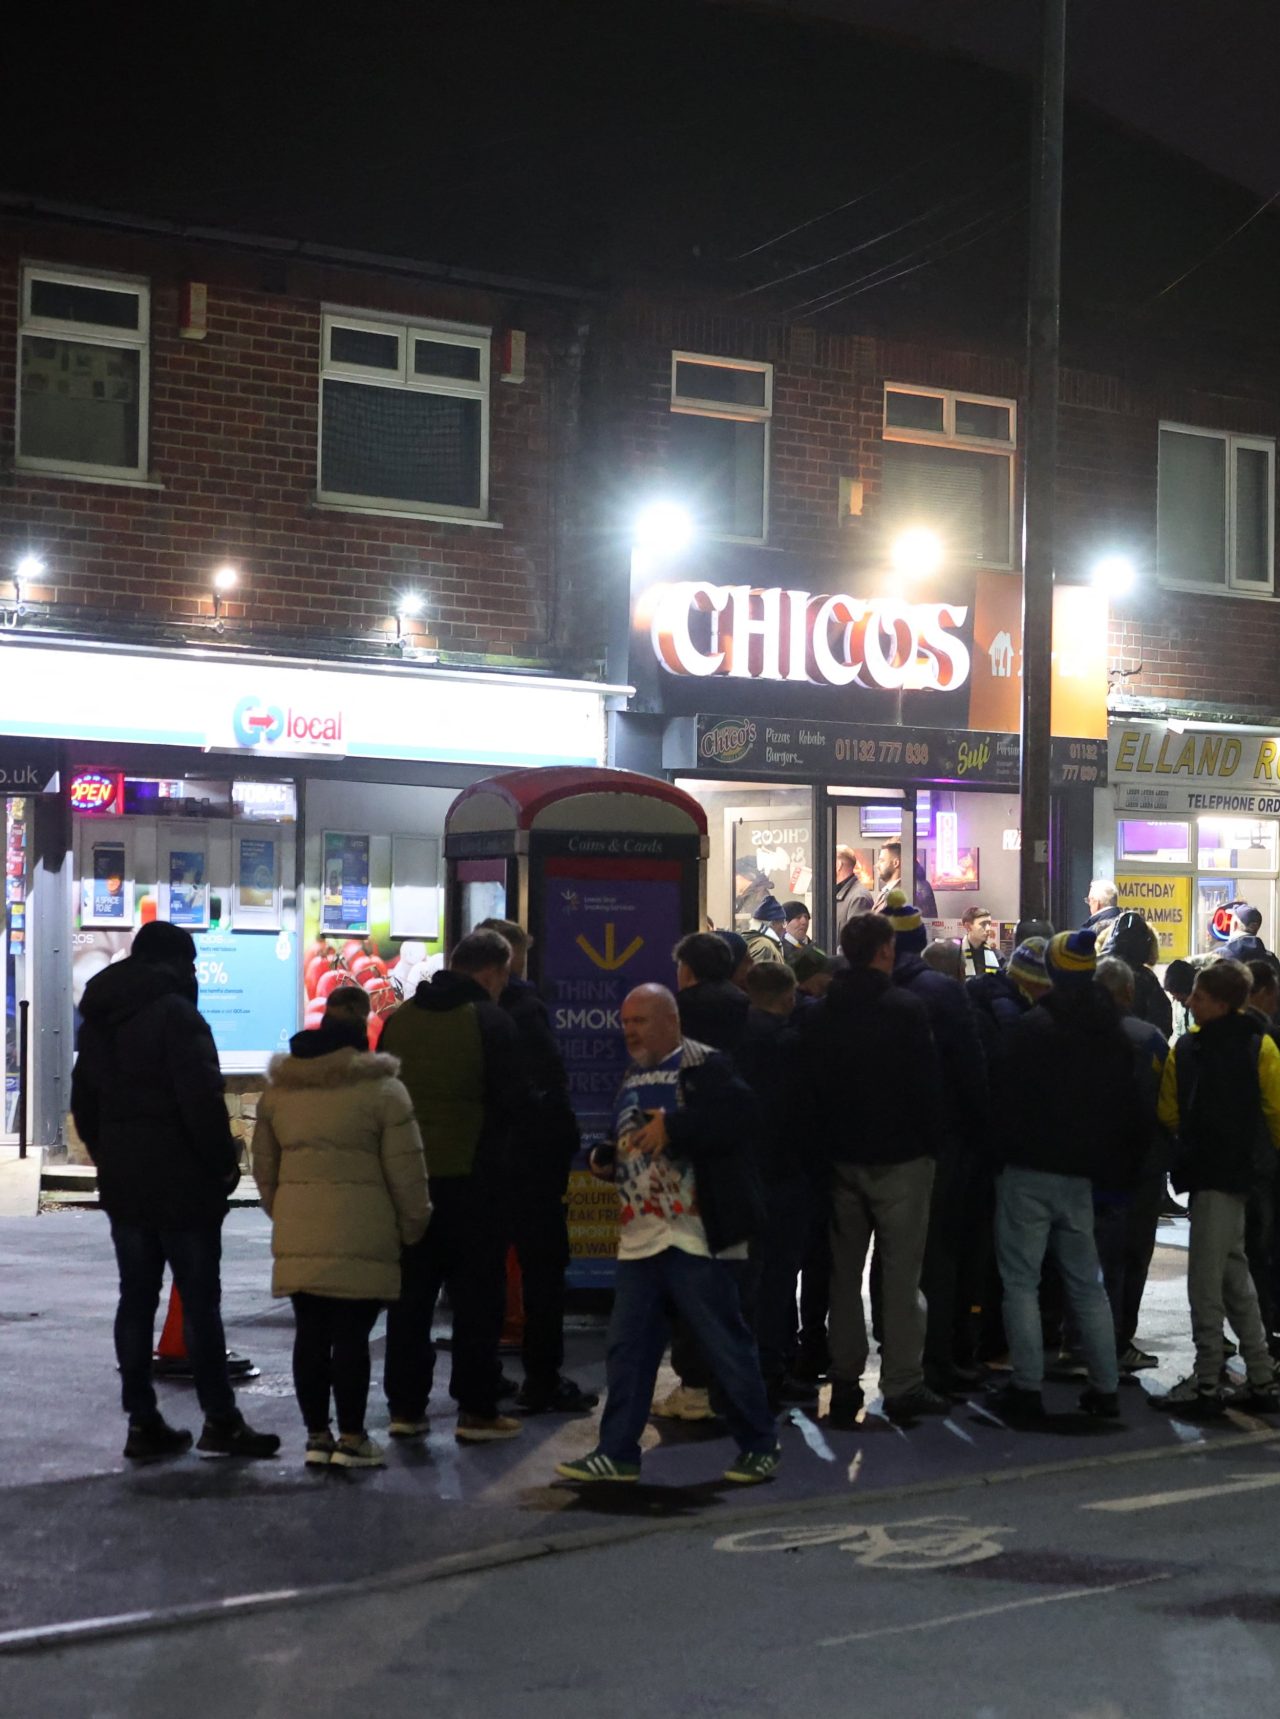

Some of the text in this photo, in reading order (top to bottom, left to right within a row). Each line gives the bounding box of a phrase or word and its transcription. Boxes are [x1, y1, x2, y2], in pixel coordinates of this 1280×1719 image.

[652, 581, 970, 691] CHICOS
[287, 707, 342, 741] local
[701, 718, 758, 758] Chico's
[766, 728, 826, 746] Pizzas Kebabs
[835, 738, 876, 762] 01132
[878, 741, 903, 763] 777
[996, 741, 1020, 757] Persia
[1115, 731, 1243, 778] ELLAND
[71, 783, 112, 801] OPEN
[1188, 793, 1255, 811] TELEPHONE
[568, 836, 663, 853] Coins & Cards
[1118, 882, 1175, 898] MATCHDAY
[1120, 907, 1183, 923] RAMMES
[1158, 932, 1173, 947] RE
[195, 961, 229, 984] 5%
[555, 981, 617, 1001] THINK
[555, 1008, 622, 1030] SMOK
[566, 1071, 620, 1093] TRES
